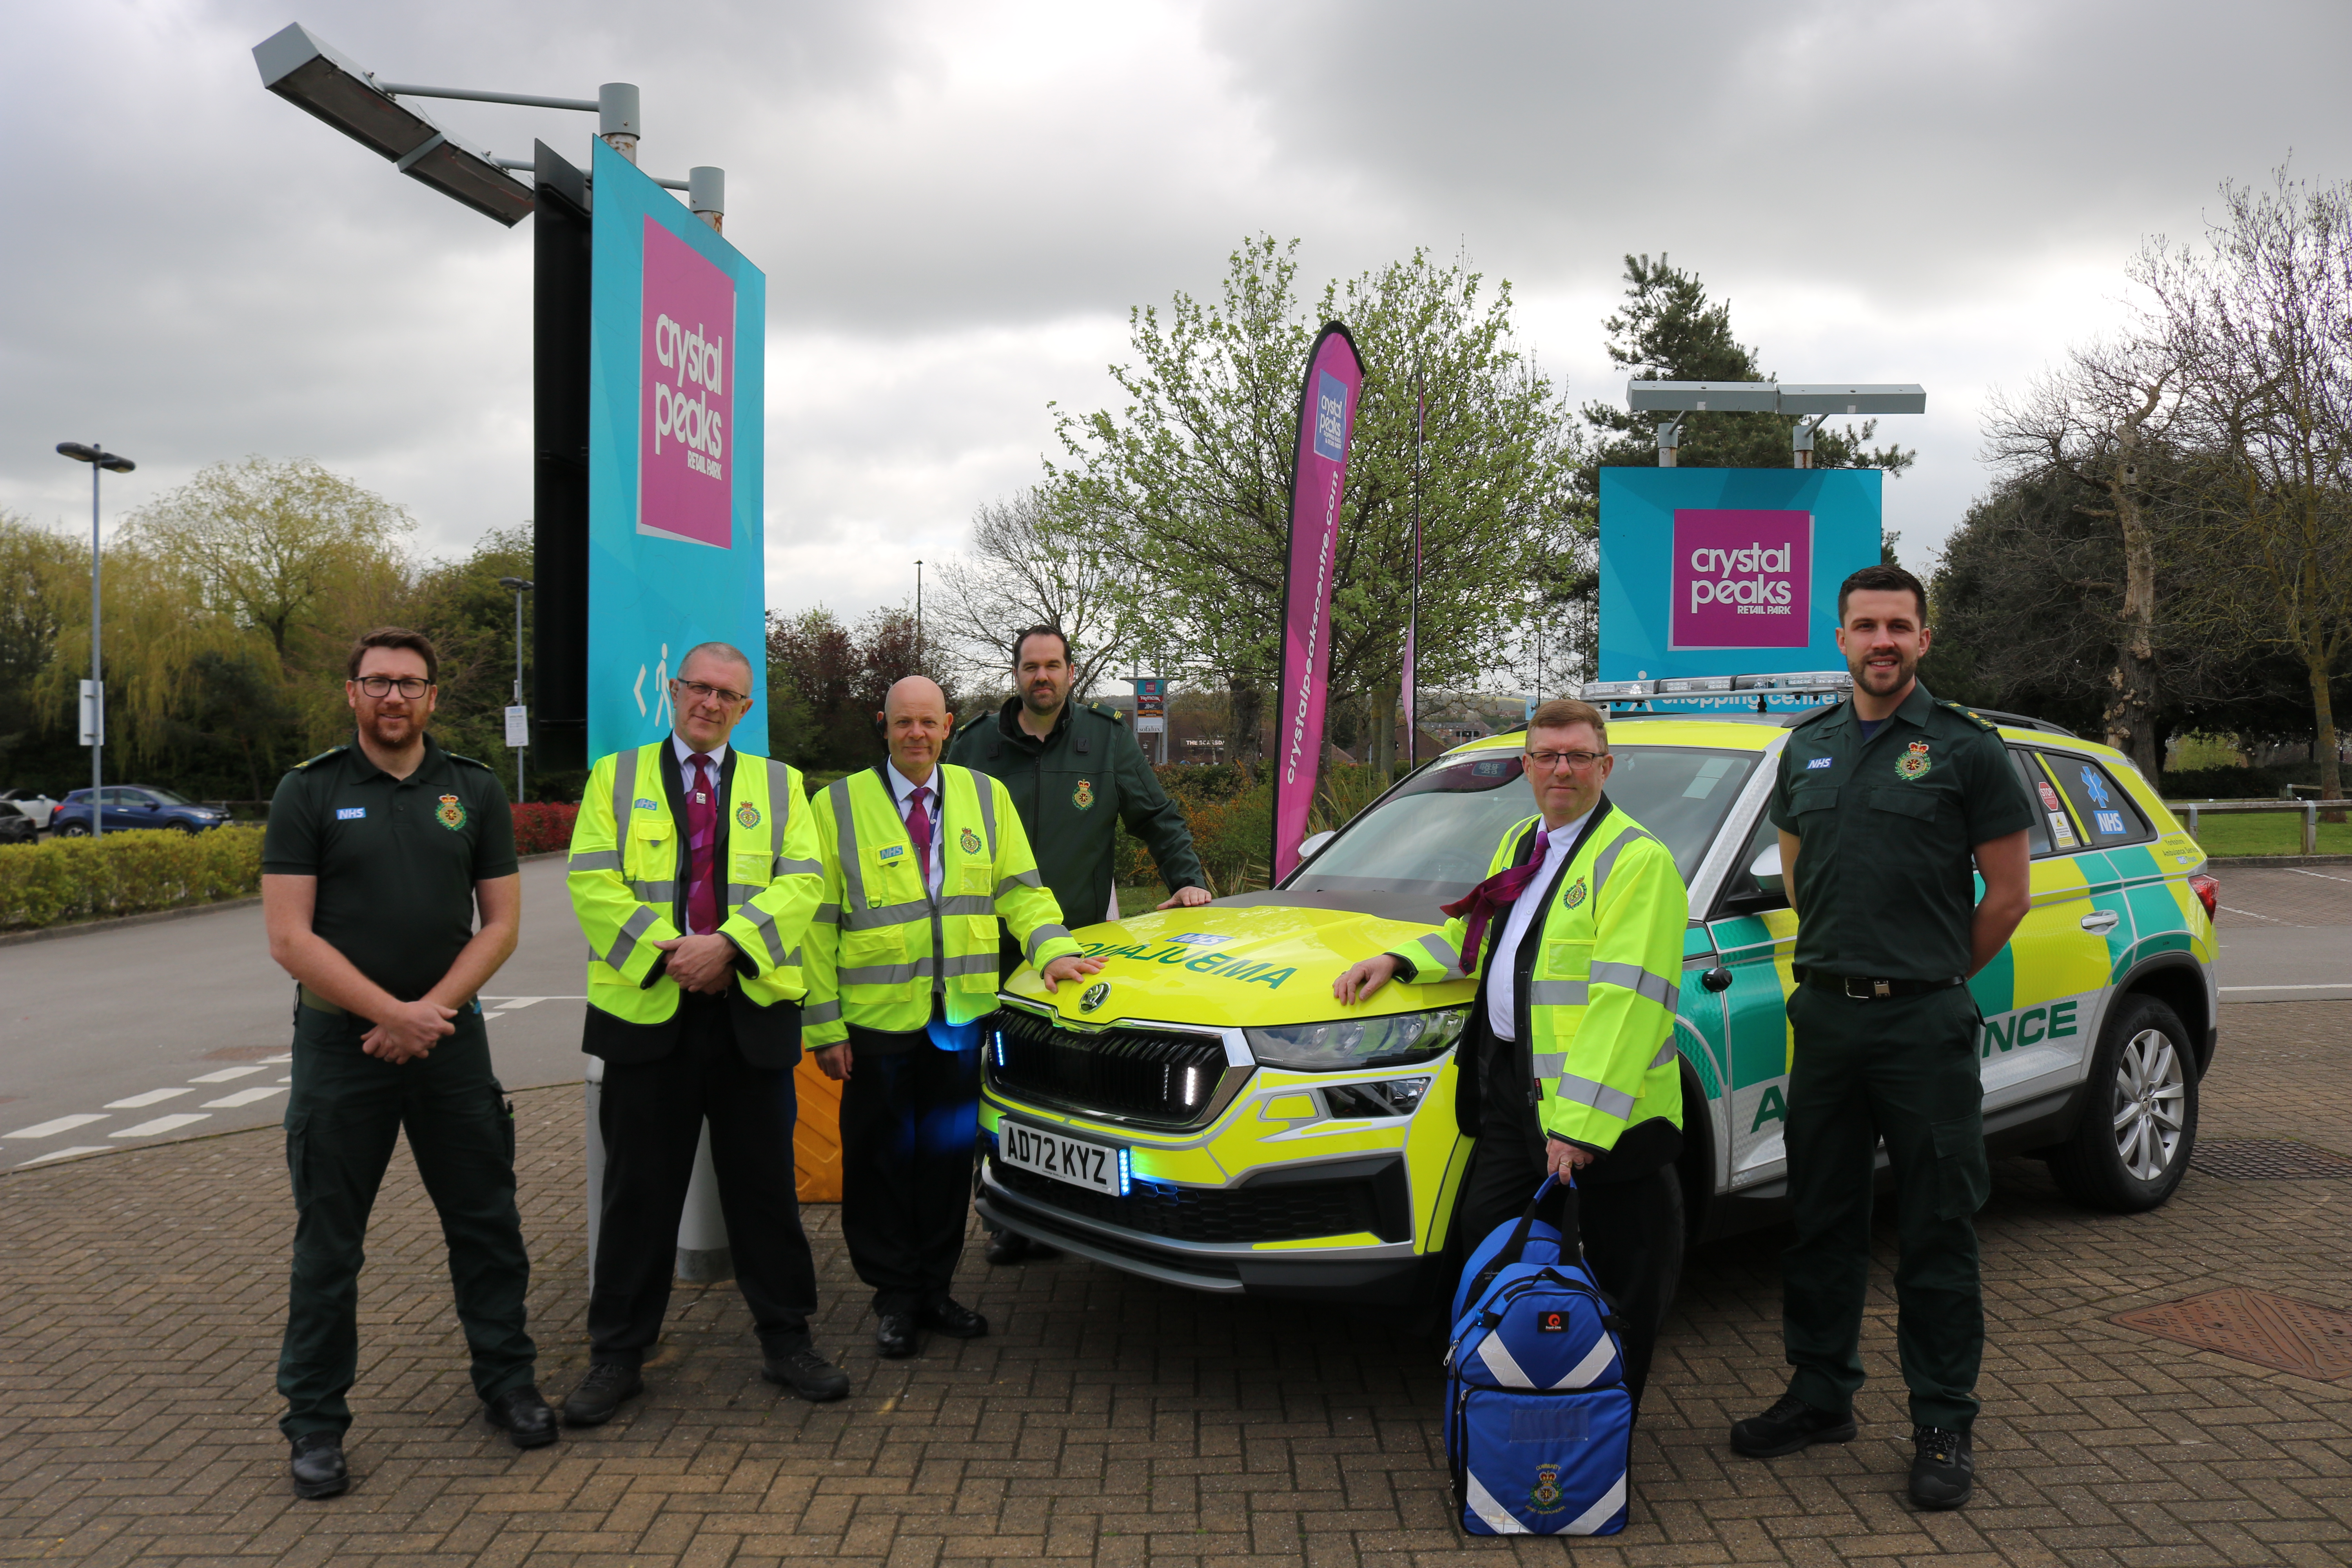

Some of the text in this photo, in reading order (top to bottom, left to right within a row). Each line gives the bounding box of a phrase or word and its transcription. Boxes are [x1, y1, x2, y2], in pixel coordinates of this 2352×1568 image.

[655, 312, 722, 396] crystal
[1321, 395, 1342, 418] crystal
[655, 381, 722, 460] peaks
[1319, 413, 1341, 437] peaks
[687, 449, 722, 481] RETAIL PARK
[1691, 542, 1790, 578] crystal
[1691, 574, 1791, 614] peaks
[1737, 605, 1791, 615] RETAIL PARK
[1287, 471, 1339, 785] crystalpeakscentre.com
[1808, 759, 1831, 769] NHS
[2040, 788, 2053, 797] STOP
[339, 808, 365, 819] NHS
[635, 799, 656, 810] NHS
[2097, 813, 2123, 832] NHS
[881, 846, 902, 858] NHS
[2162, 848, 2187, 857] Ambulance
[1171, 934, 1230, 946] NHS
[1007, 1127, 1107, 1185] AD72 KYZ
[1525, 1505, 1537, 1513] FIRST
